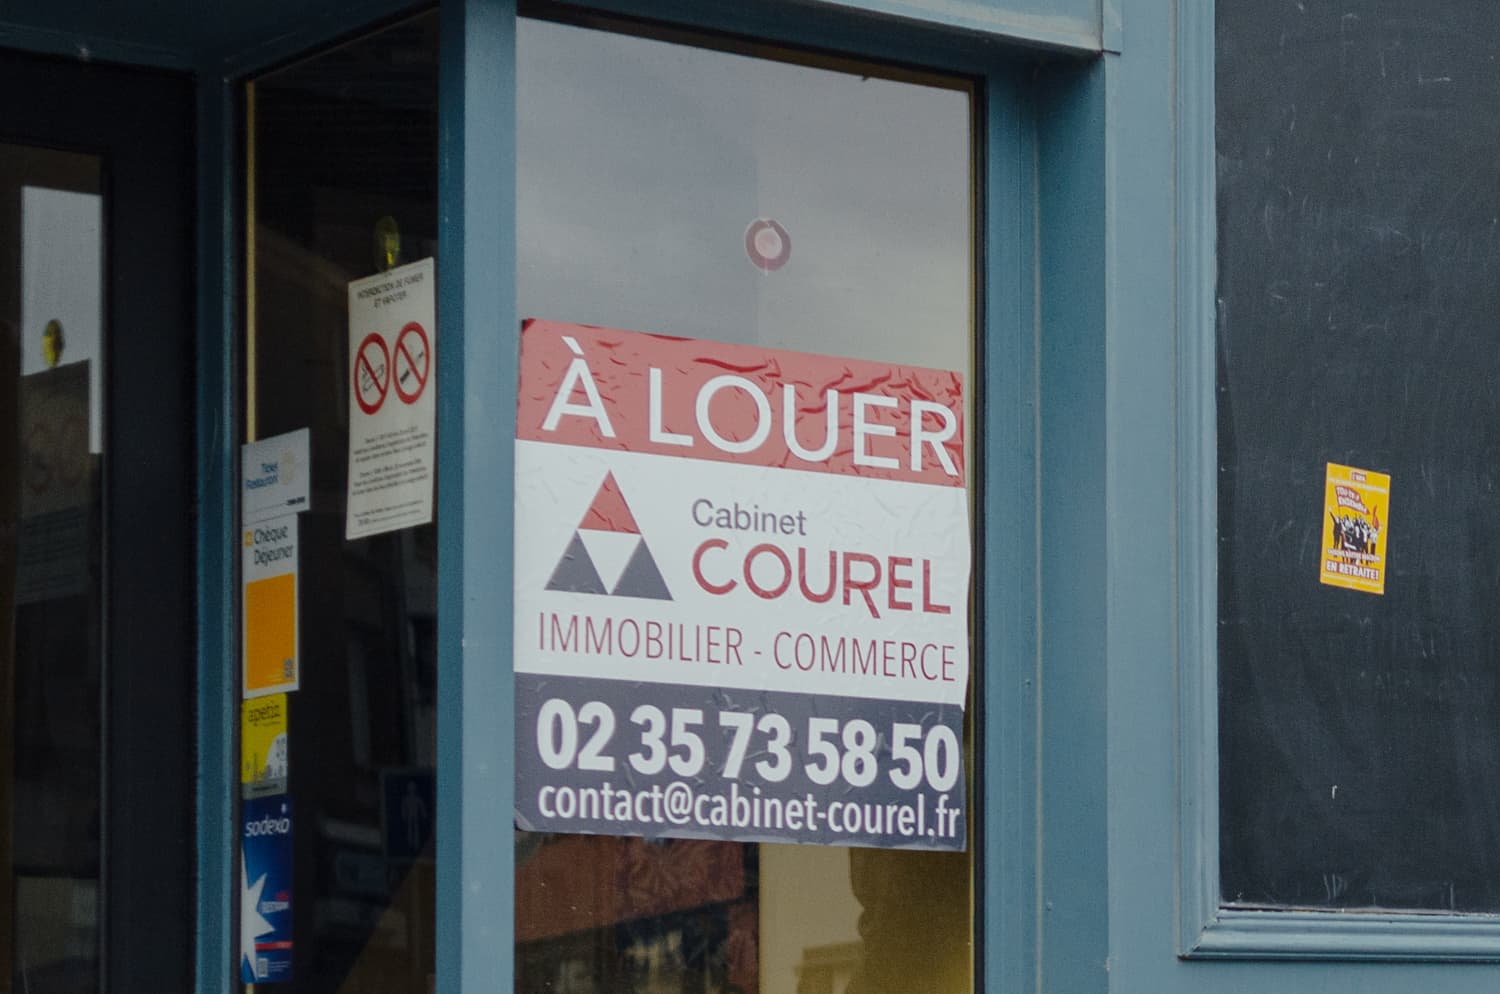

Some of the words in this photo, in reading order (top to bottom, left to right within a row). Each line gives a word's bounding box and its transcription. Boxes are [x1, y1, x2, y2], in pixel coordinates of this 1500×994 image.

[542, 336, 617, 438] À
[649, 367, 959, 476] LOUER
[254, 525, 289, 545] Chèque
[691, 498, 807, 537] Cabinet
[692, 537, 952, 619] COUREL
[1325, 560, 1338, 573] EN
[1338, 561, 1380, 580] RETRAITE!
[538, 611, 743, 666] IMMOBILIER
[773, 631, 956, 681] COMMERCE
[537, 698, 616, 772] 02
[628, 703, 706, 778] 35
[719, 708, 793, 784] 73
[804, 717, 878, 787] 58
[888, 722, 960, 792] 50
[244, 814, 291, 838] sodexo
[538, 781, 961, 838] contact@cabinet-courel.fr
